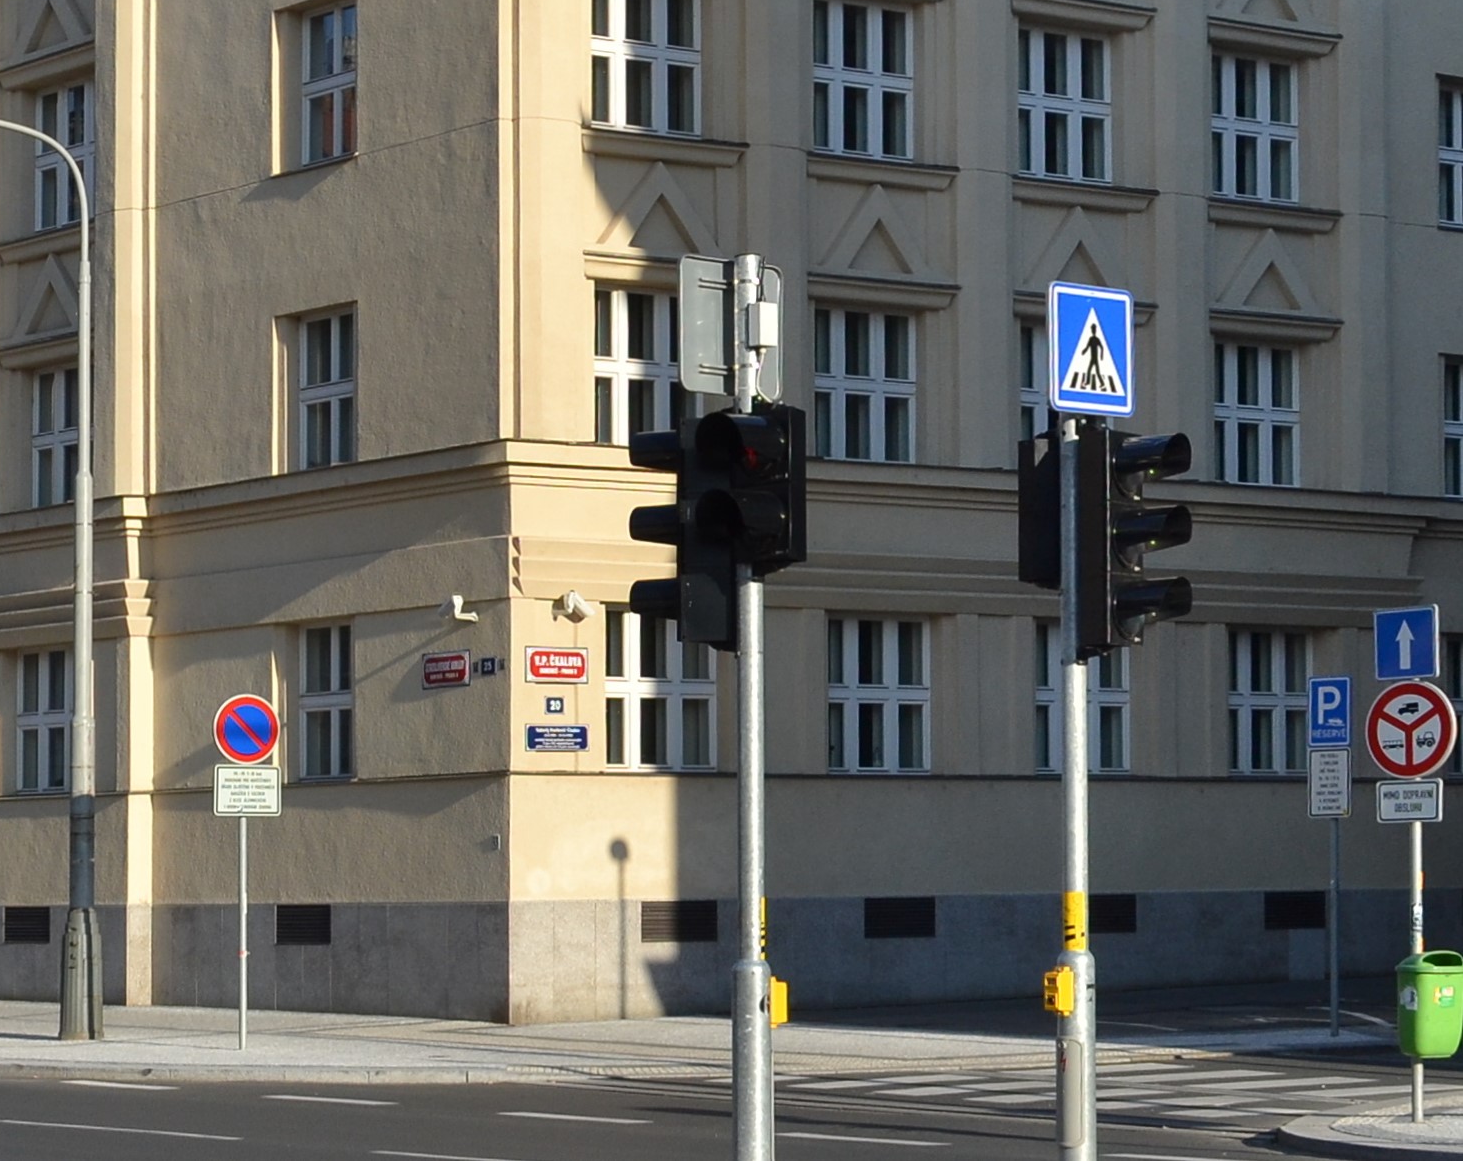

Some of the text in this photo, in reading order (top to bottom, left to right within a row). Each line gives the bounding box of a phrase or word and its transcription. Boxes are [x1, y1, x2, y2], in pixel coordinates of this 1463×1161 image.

[483, 661, 492, 671] 25
[549, 699, 561, 711] 20
[1317, 685, 1341, 725] P
[1383, 790, 1400, 800] MIMO
[1394, 802, 1423, 813] OBSLUHU
